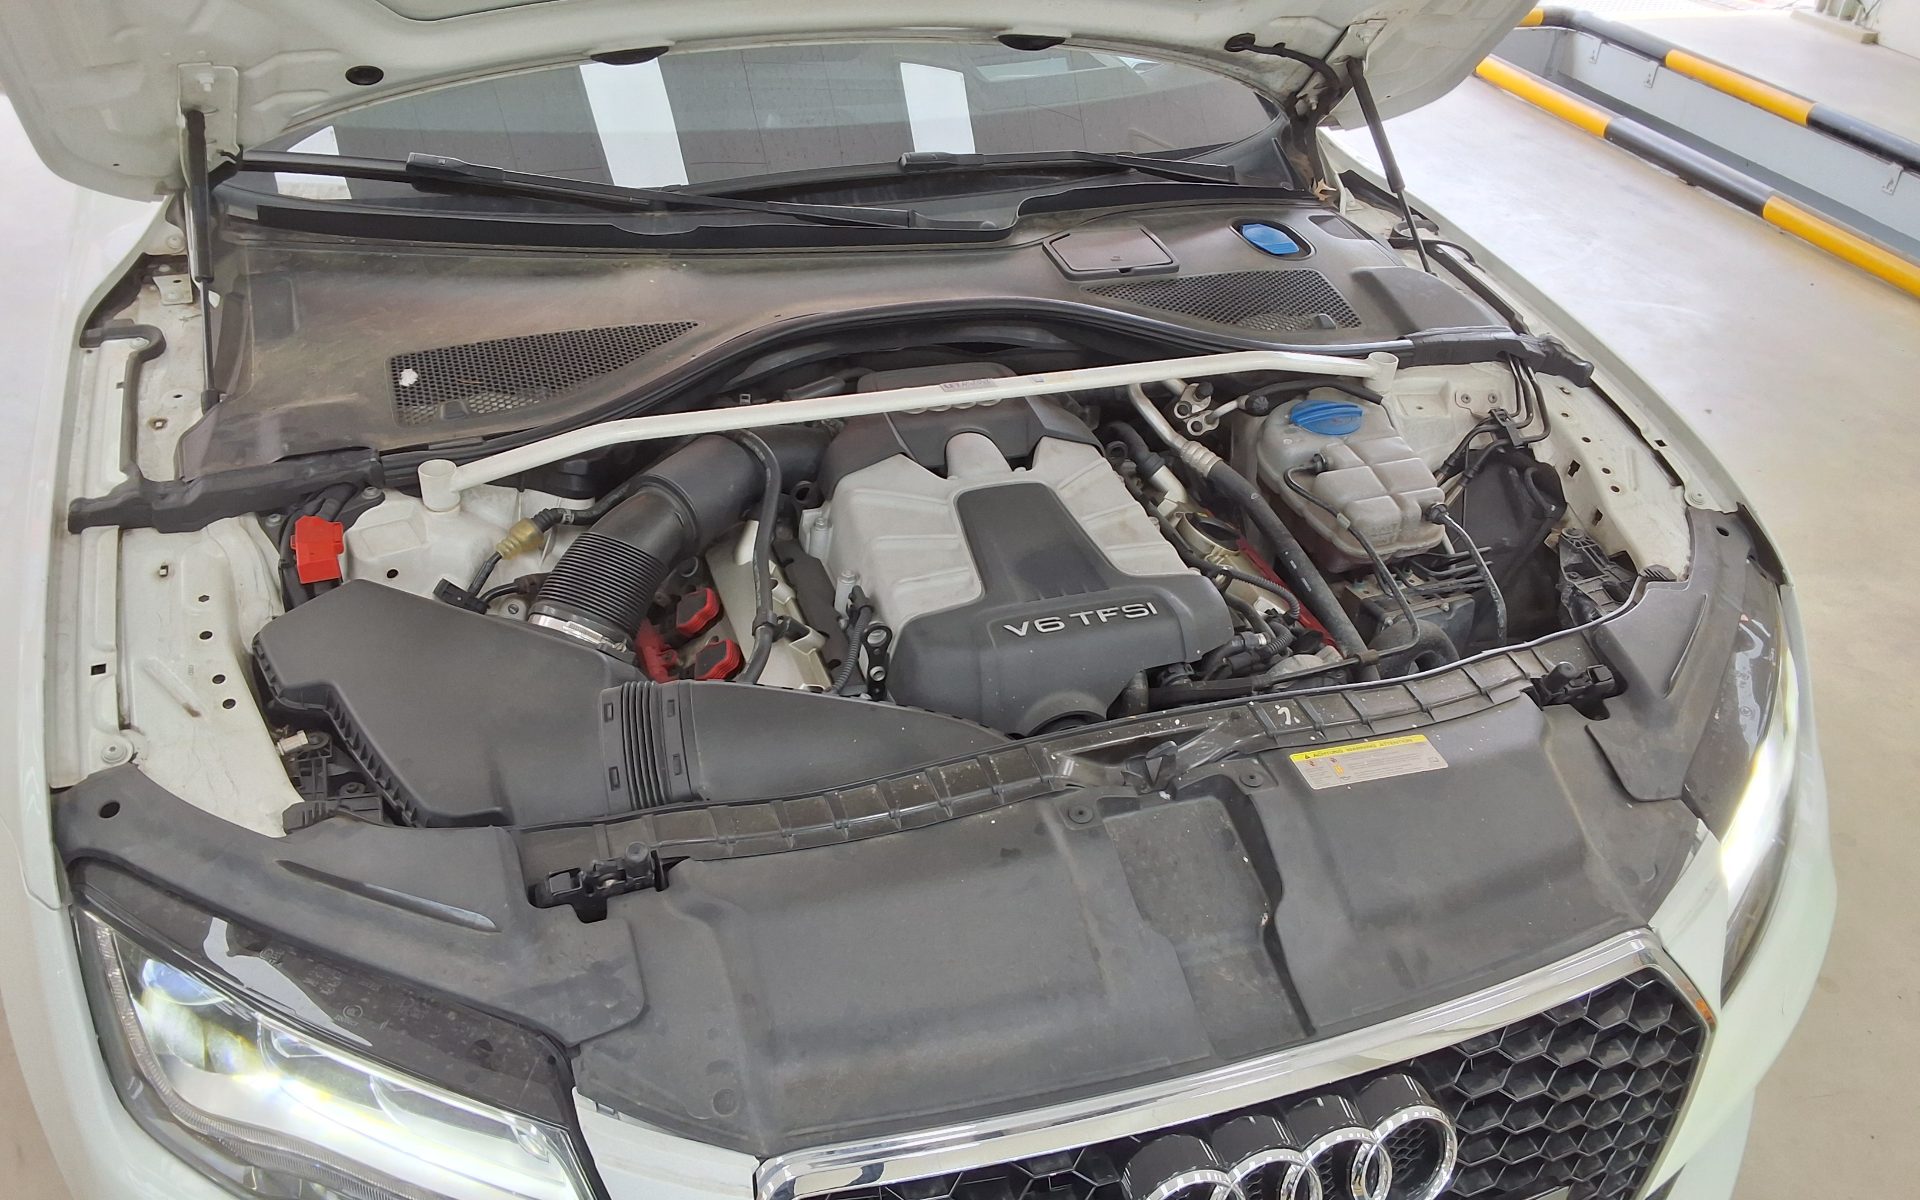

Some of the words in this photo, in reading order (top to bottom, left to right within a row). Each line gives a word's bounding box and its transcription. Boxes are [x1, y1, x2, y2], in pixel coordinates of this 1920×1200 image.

[1003, 616, 1066, 637] V6
[1068, 601, 1159, 626] TFSI
[1313, 748, 1344, 758] ACHTUNG
[1379, 738, 1414, 748] ATTENTION
